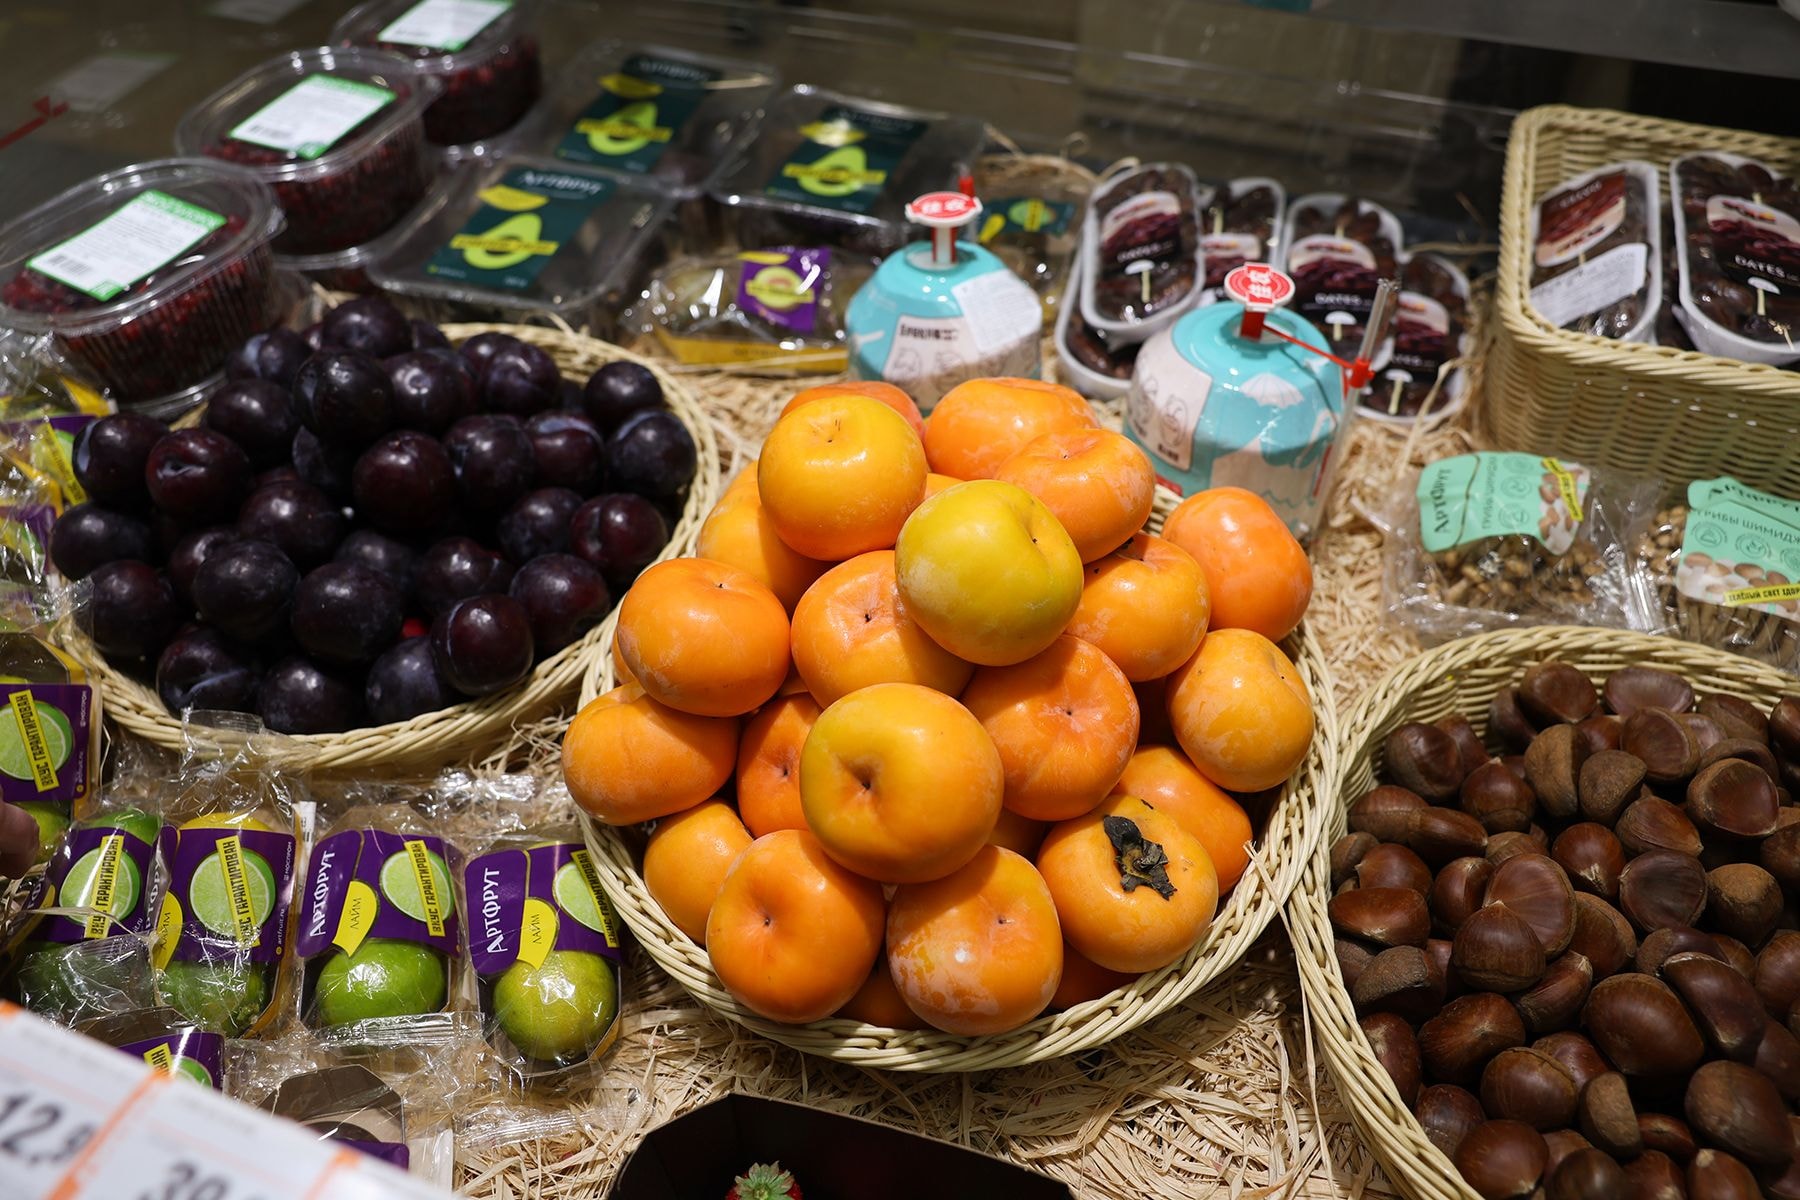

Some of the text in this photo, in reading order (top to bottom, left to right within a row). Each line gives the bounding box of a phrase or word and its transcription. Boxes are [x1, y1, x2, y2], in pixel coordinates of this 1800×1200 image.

[1734, 254, 1786, 279] DATES
[15, 694, 55, 787] ВКУС ГАРАНТИРОВАН
[95, 838, 119, 907] ГАРАНТИРОВАН
[223, 840, 250, 915] ГАРАНТИРОВАН
[410, 843, 442, 933] ВКУС ГАРАНТИРОВАН
[577, 852, 610, 915] ГАРАНТИРОВАН
[350, 897, 362, 930] ЛАЙМ
[482, 867, 508, 954] АРТФРУТ
[529, 913, 541, 945] ЛАЙМ
